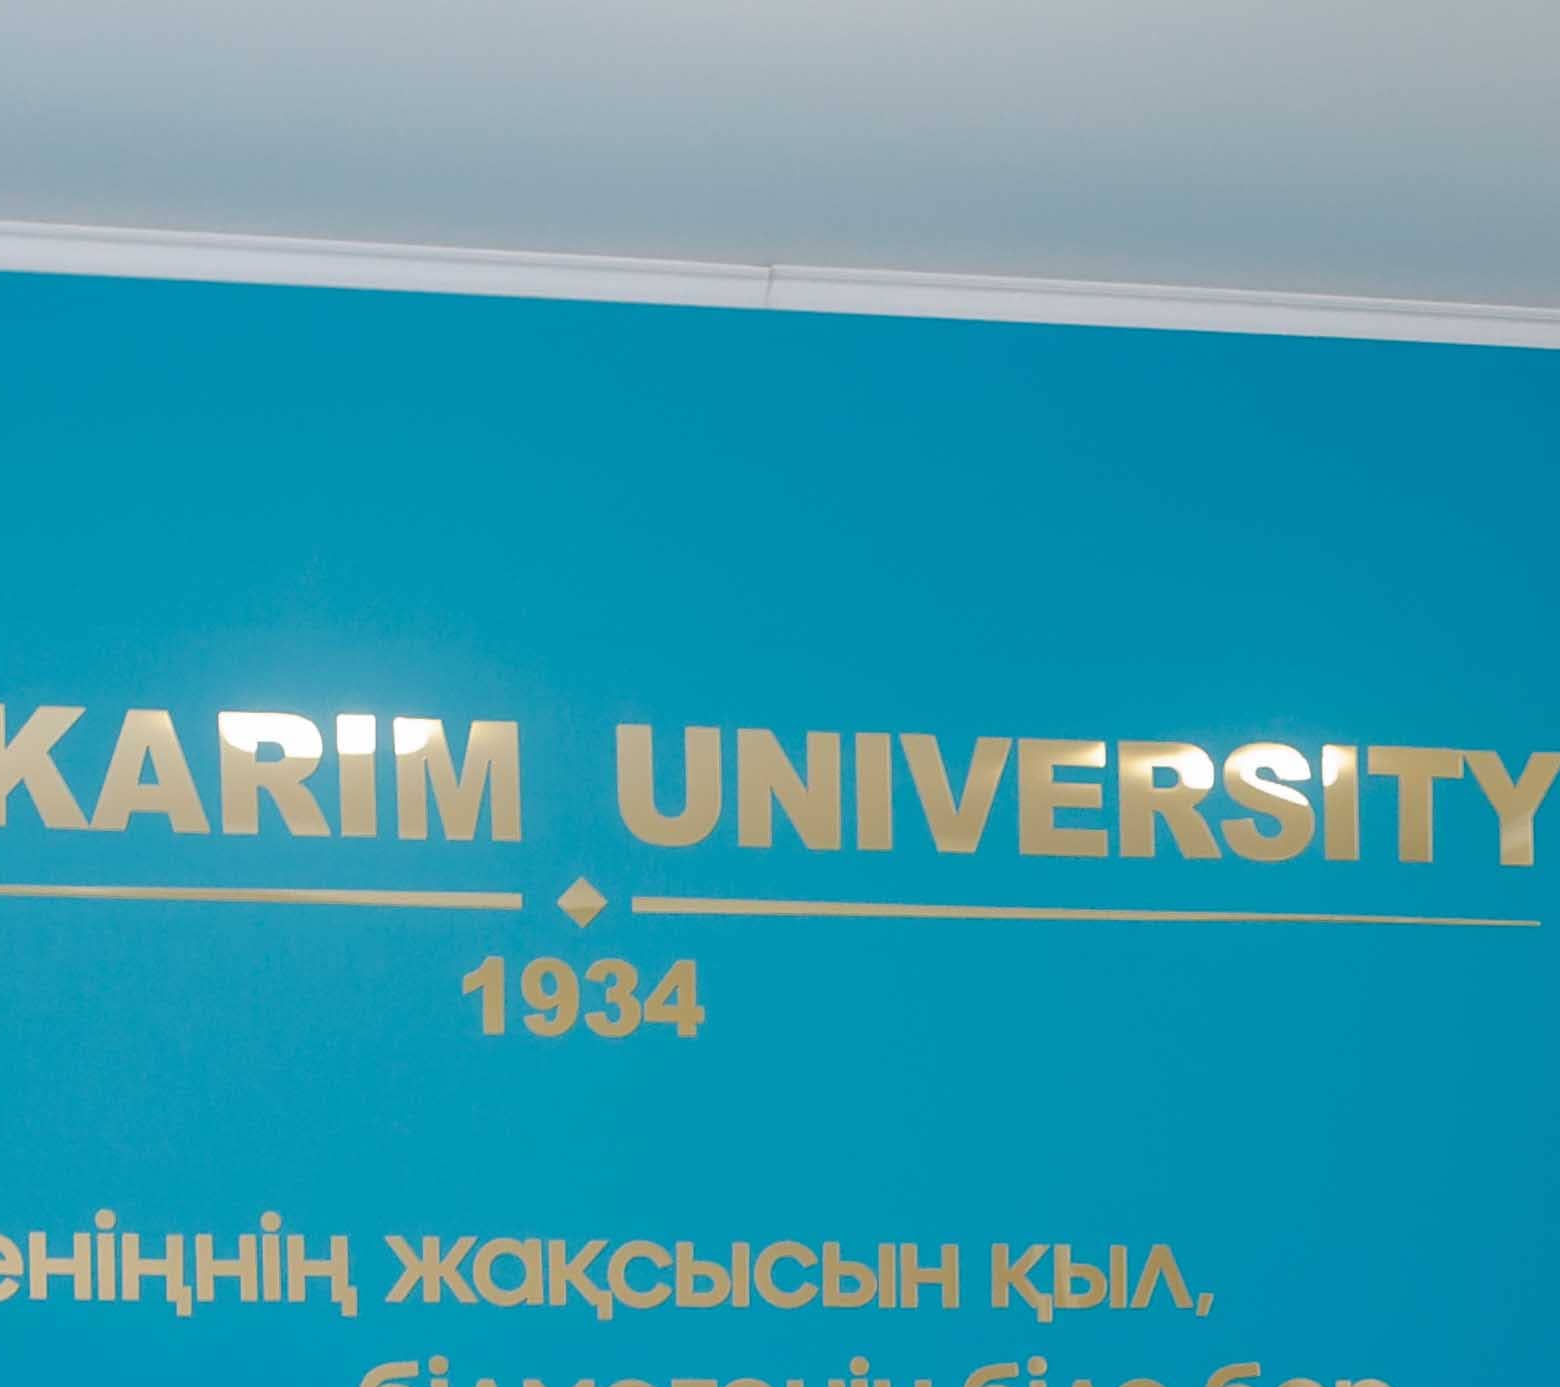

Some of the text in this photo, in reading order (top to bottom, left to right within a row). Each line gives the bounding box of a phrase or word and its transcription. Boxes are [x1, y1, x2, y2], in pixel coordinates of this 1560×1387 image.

[461, 954, 706, 1039] 1934
[384, 1232, 961, 1321] жақсысын
[990, 1242, 1214, 1324] қыл,
